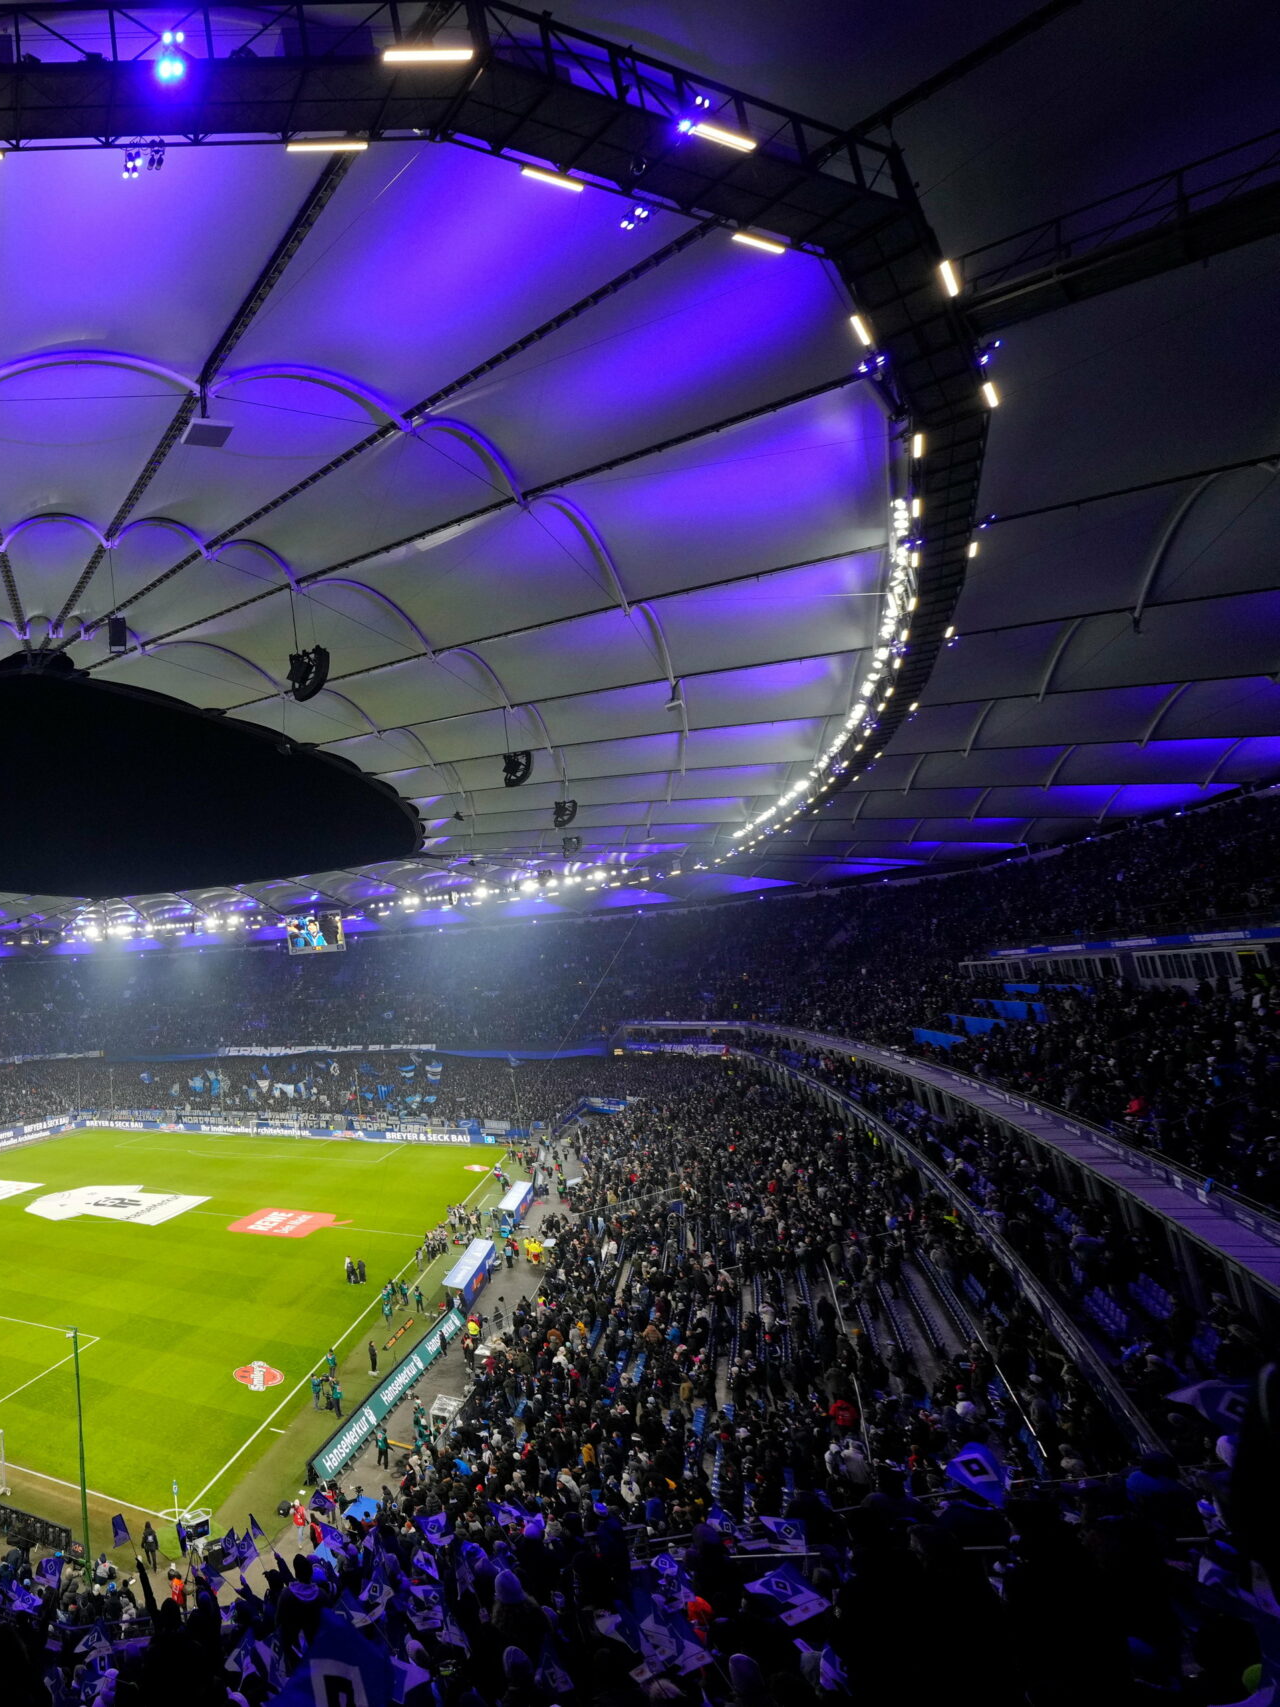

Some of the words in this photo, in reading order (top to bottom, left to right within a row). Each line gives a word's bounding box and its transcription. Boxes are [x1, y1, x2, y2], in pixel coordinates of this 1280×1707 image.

[385, 1131, 418, 1141] BREYER
[419, 1132, 426, 1141] &
[427, 1133, 451, 1142] SECK
[452, 1133, 471, 1143] BAU
[247, 1211, 296, 1232] REWE
[425, 1319, 455, 1355] Hanserkur
[380, 1363, 418, 1406] HanseMerkur
[322, 1415, 371, 1473] HanseMerkur
